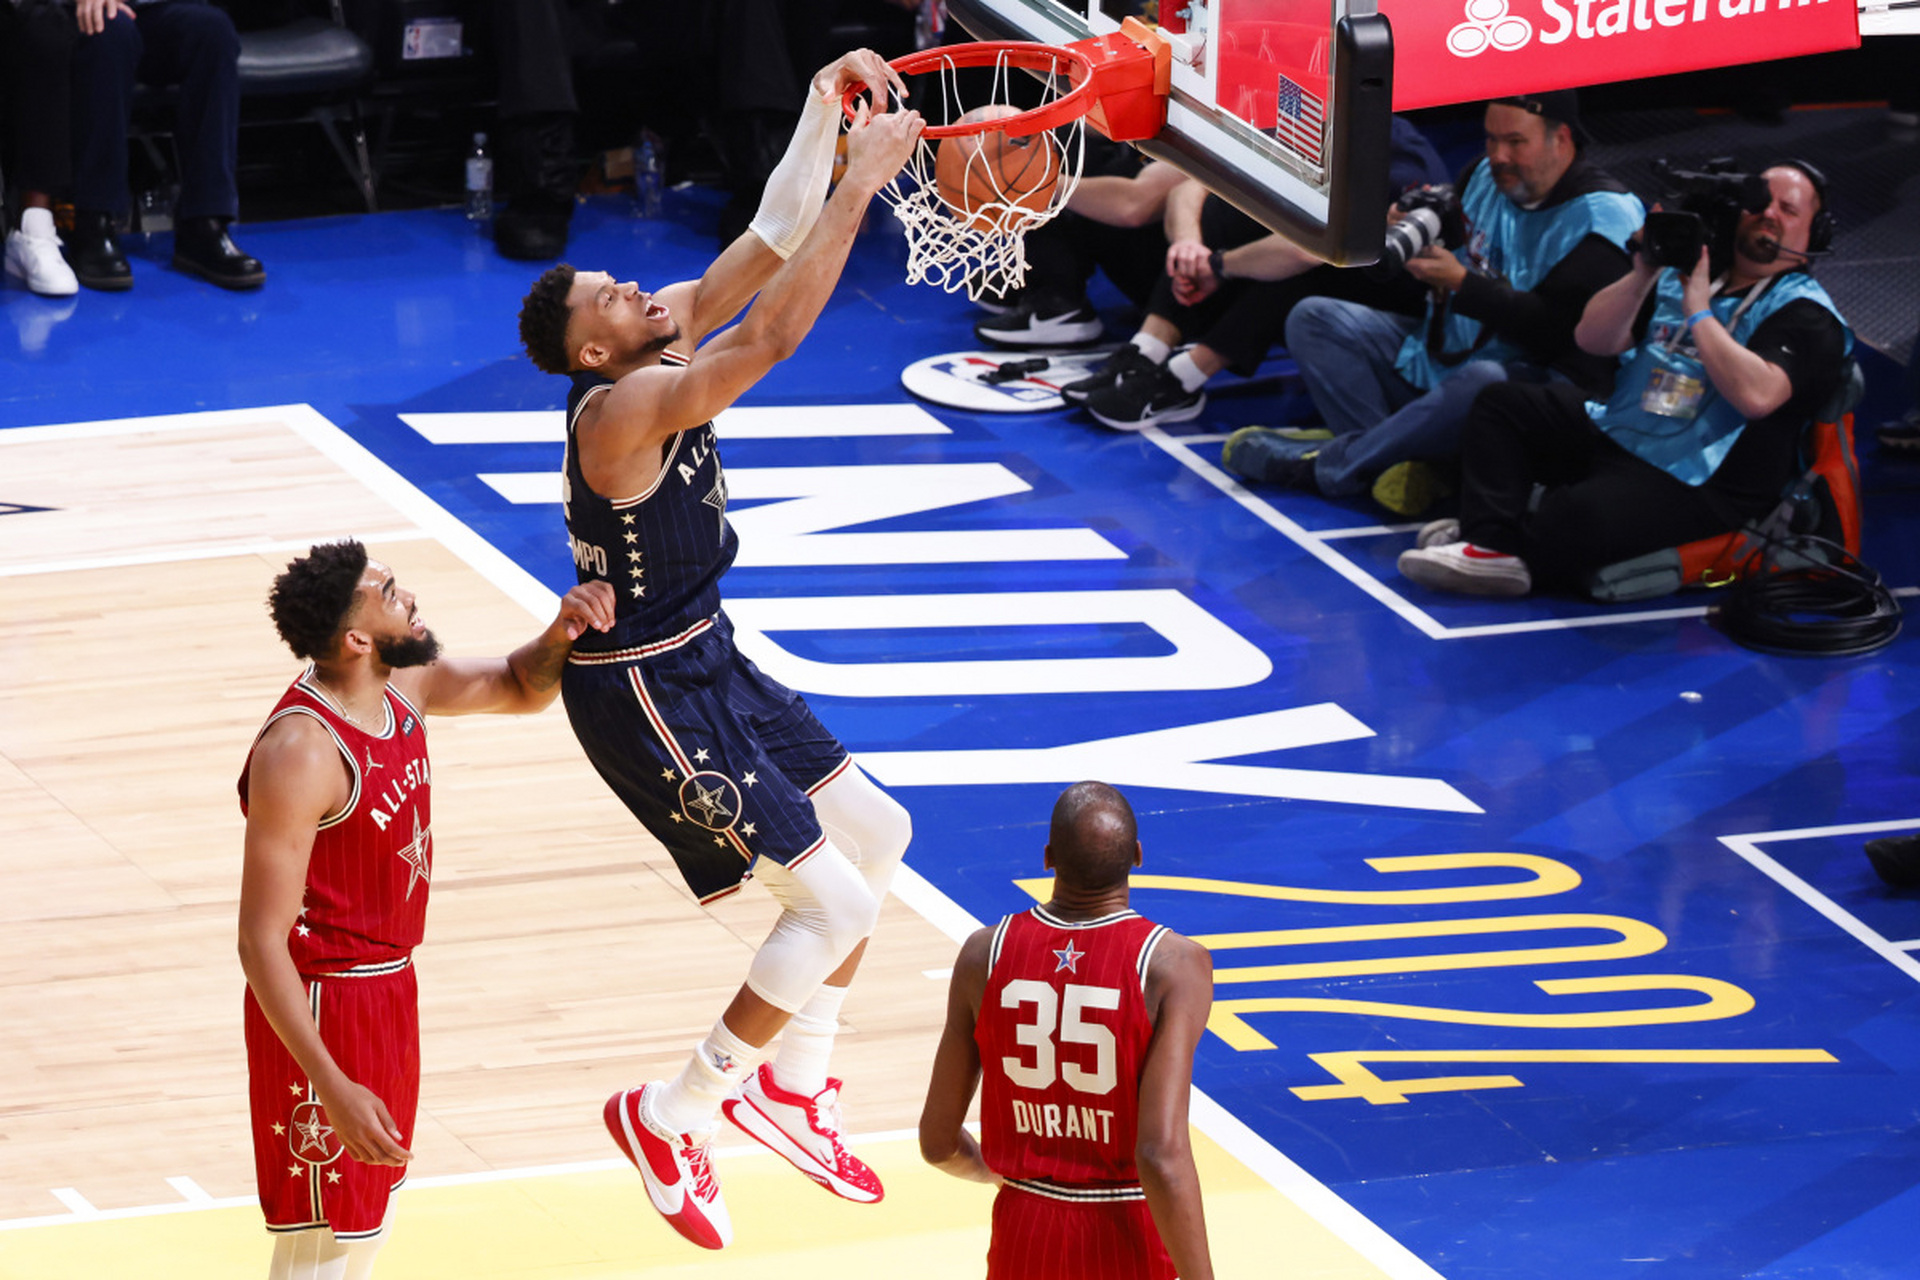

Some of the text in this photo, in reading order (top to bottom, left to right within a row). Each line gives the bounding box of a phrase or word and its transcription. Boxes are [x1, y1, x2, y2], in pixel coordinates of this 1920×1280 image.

[398, 402, 1485, 814] INDY
[1000, 978, 1121, 1096] 35
[1013, 851, 1841, 1105] 2024
[1012, 1099, 1115, 1145] DURANT
